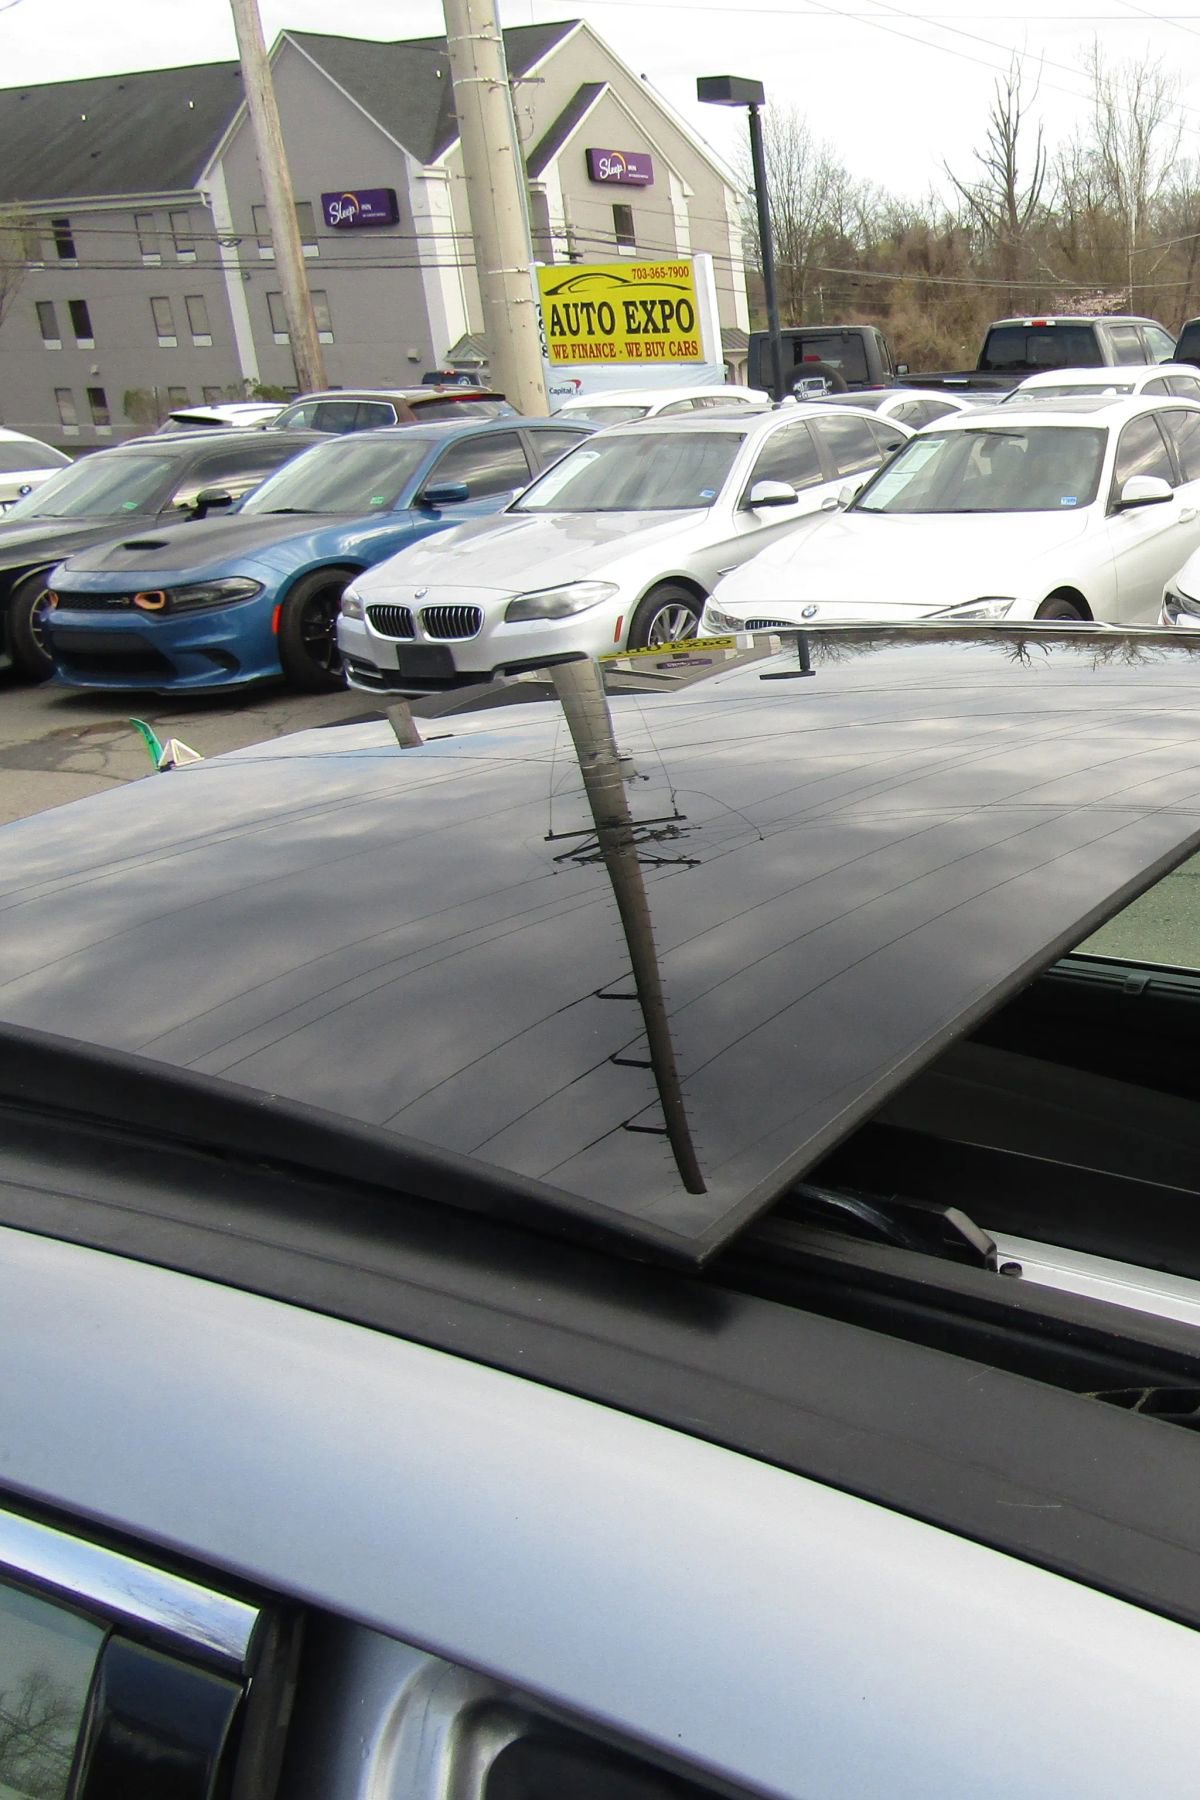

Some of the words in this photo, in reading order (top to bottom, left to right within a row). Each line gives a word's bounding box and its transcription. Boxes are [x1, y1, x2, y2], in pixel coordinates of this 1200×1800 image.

[599, 158, 624, 179] Sleep
[329, 201, 357, 225] Sleep
[631, 265, 690, 280] 703-365-7900
[550, 301, 616, 337] AUTO
[622, 298, 695, 334] EXPO
[552, 343, 569, 359] WE
[570, 342, 617, 359] FINANCE
[625, 341, 643, 358] WE
[644, 341, 666, 357] BUY
[669, 340, 699, 356] CARS
